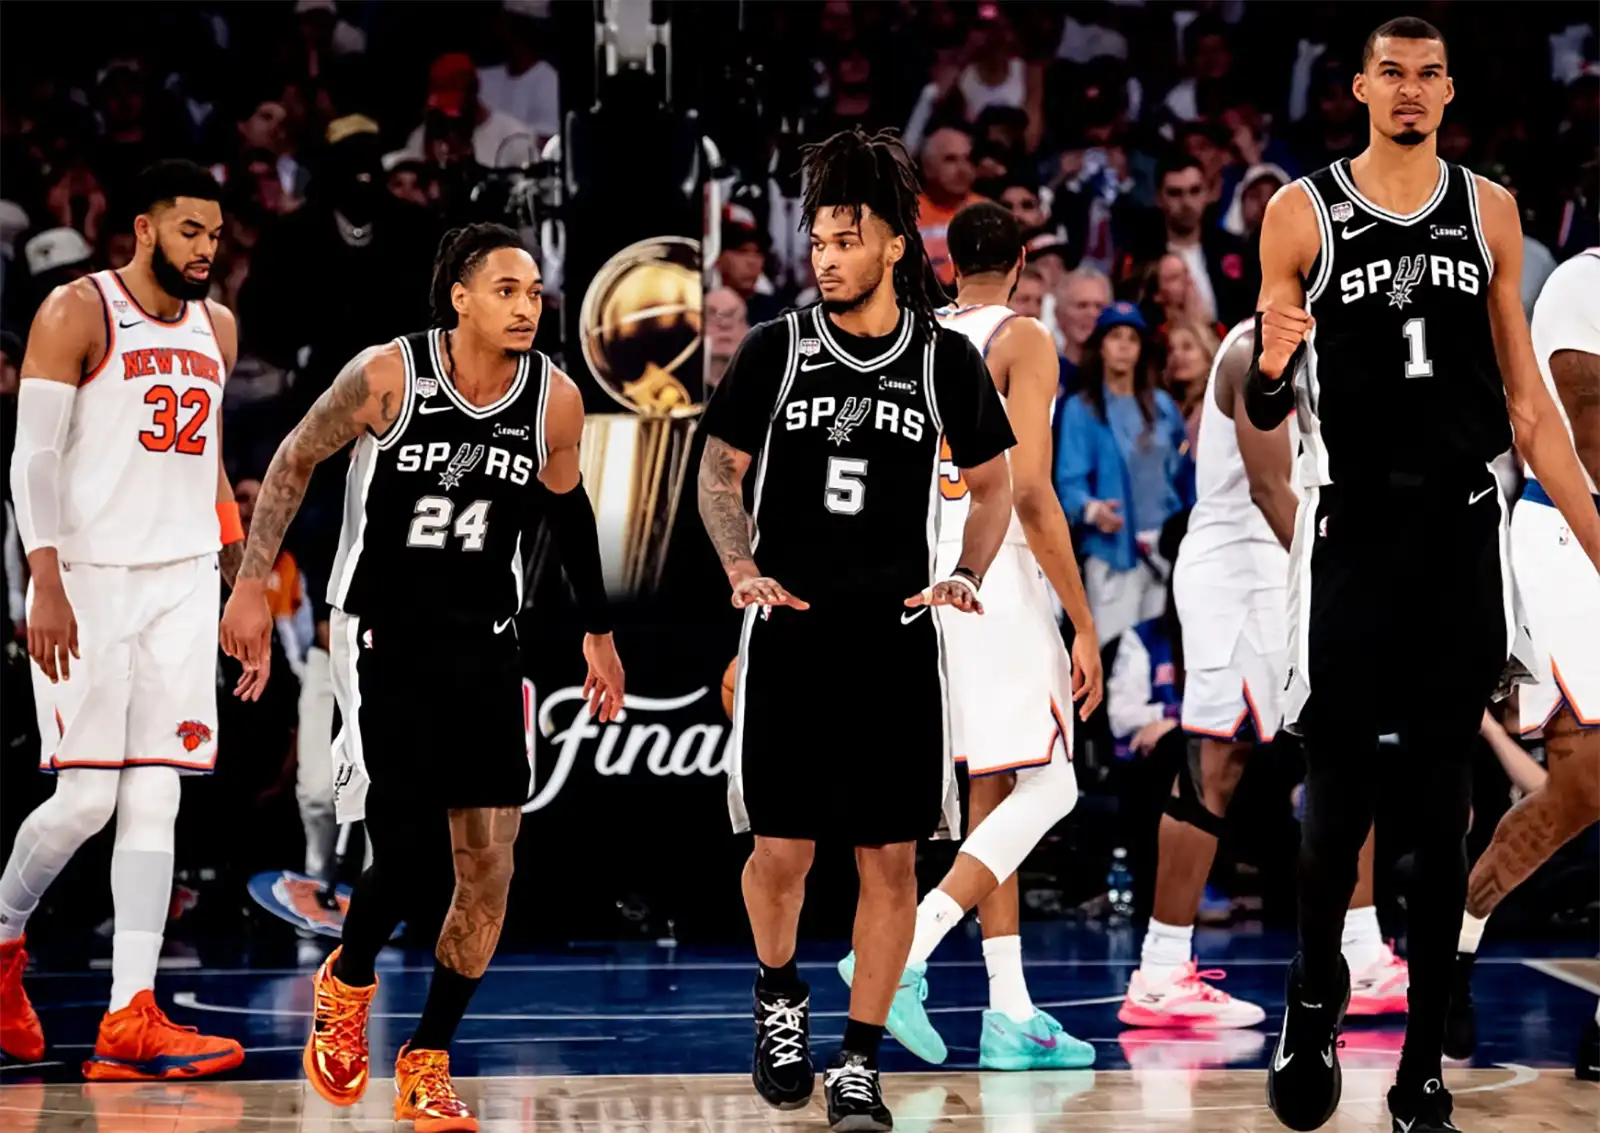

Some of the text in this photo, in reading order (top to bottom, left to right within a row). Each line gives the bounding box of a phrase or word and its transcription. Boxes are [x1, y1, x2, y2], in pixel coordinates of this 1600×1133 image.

[1340, 254, 1480, 310] SPURS
[121, 347, 173, 381] NEW
[1402, 317, 1434, 379] 1
[138, 384, 211, 456] 32
[785, 396, 926, 447] SPURS
[396, 442, 533, 491] SPURS
[824, 456, 869, 516] 5
[406, 495, 493, 552] 24
